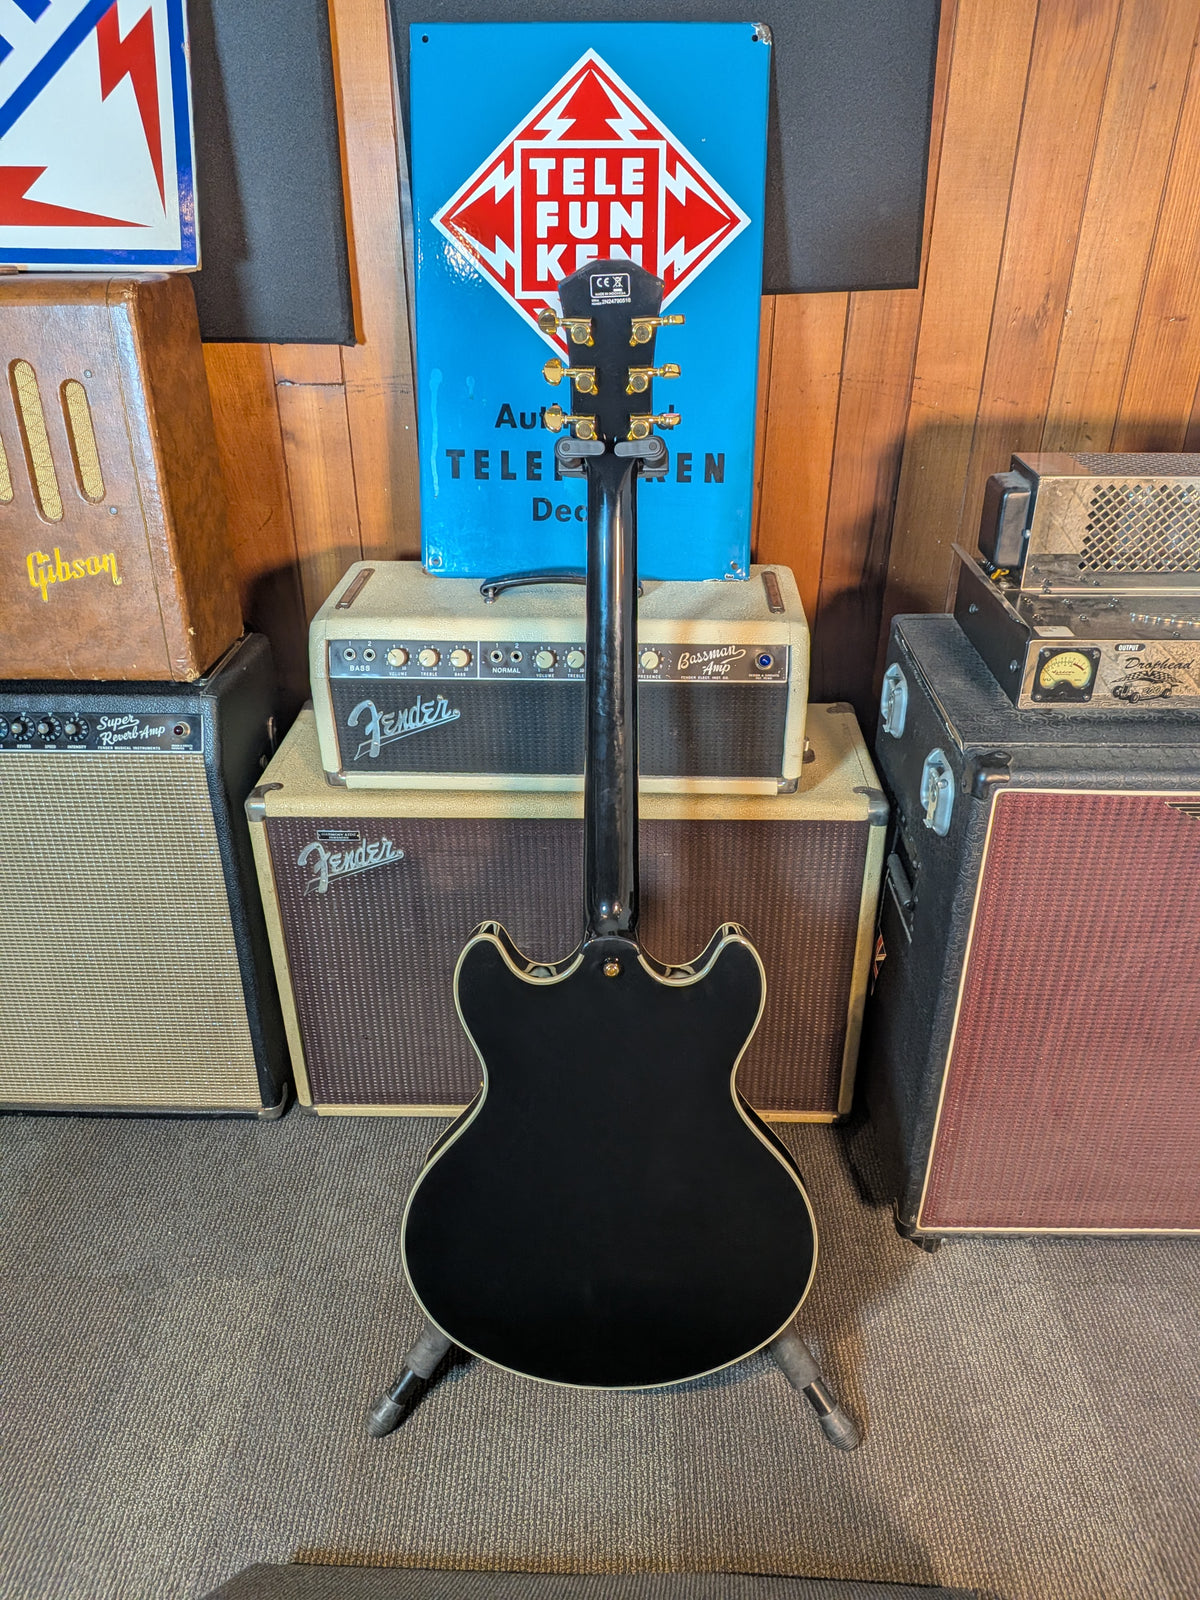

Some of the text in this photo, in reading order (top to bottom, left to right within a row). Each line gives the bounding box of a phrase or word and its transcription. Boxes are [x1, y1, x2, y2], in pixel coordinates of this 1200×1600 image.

[529, 157, 644, 195] TELE
[536, 201, 643, 239] FUN
[445, 449, 726, 484] TELEEN
[26, 547, 123, 603] Gibson
[349, 664, 371, 672] BASS
[677, 645, 747, 671] Bassman
[702, 661, 731, 676] Amp
[1124, 657, 1195, 671] Drophead
[96, 714, 140, 731] Super
[347, 694, 461, 761] Fender
[297, 836, 405, 897] Fender
